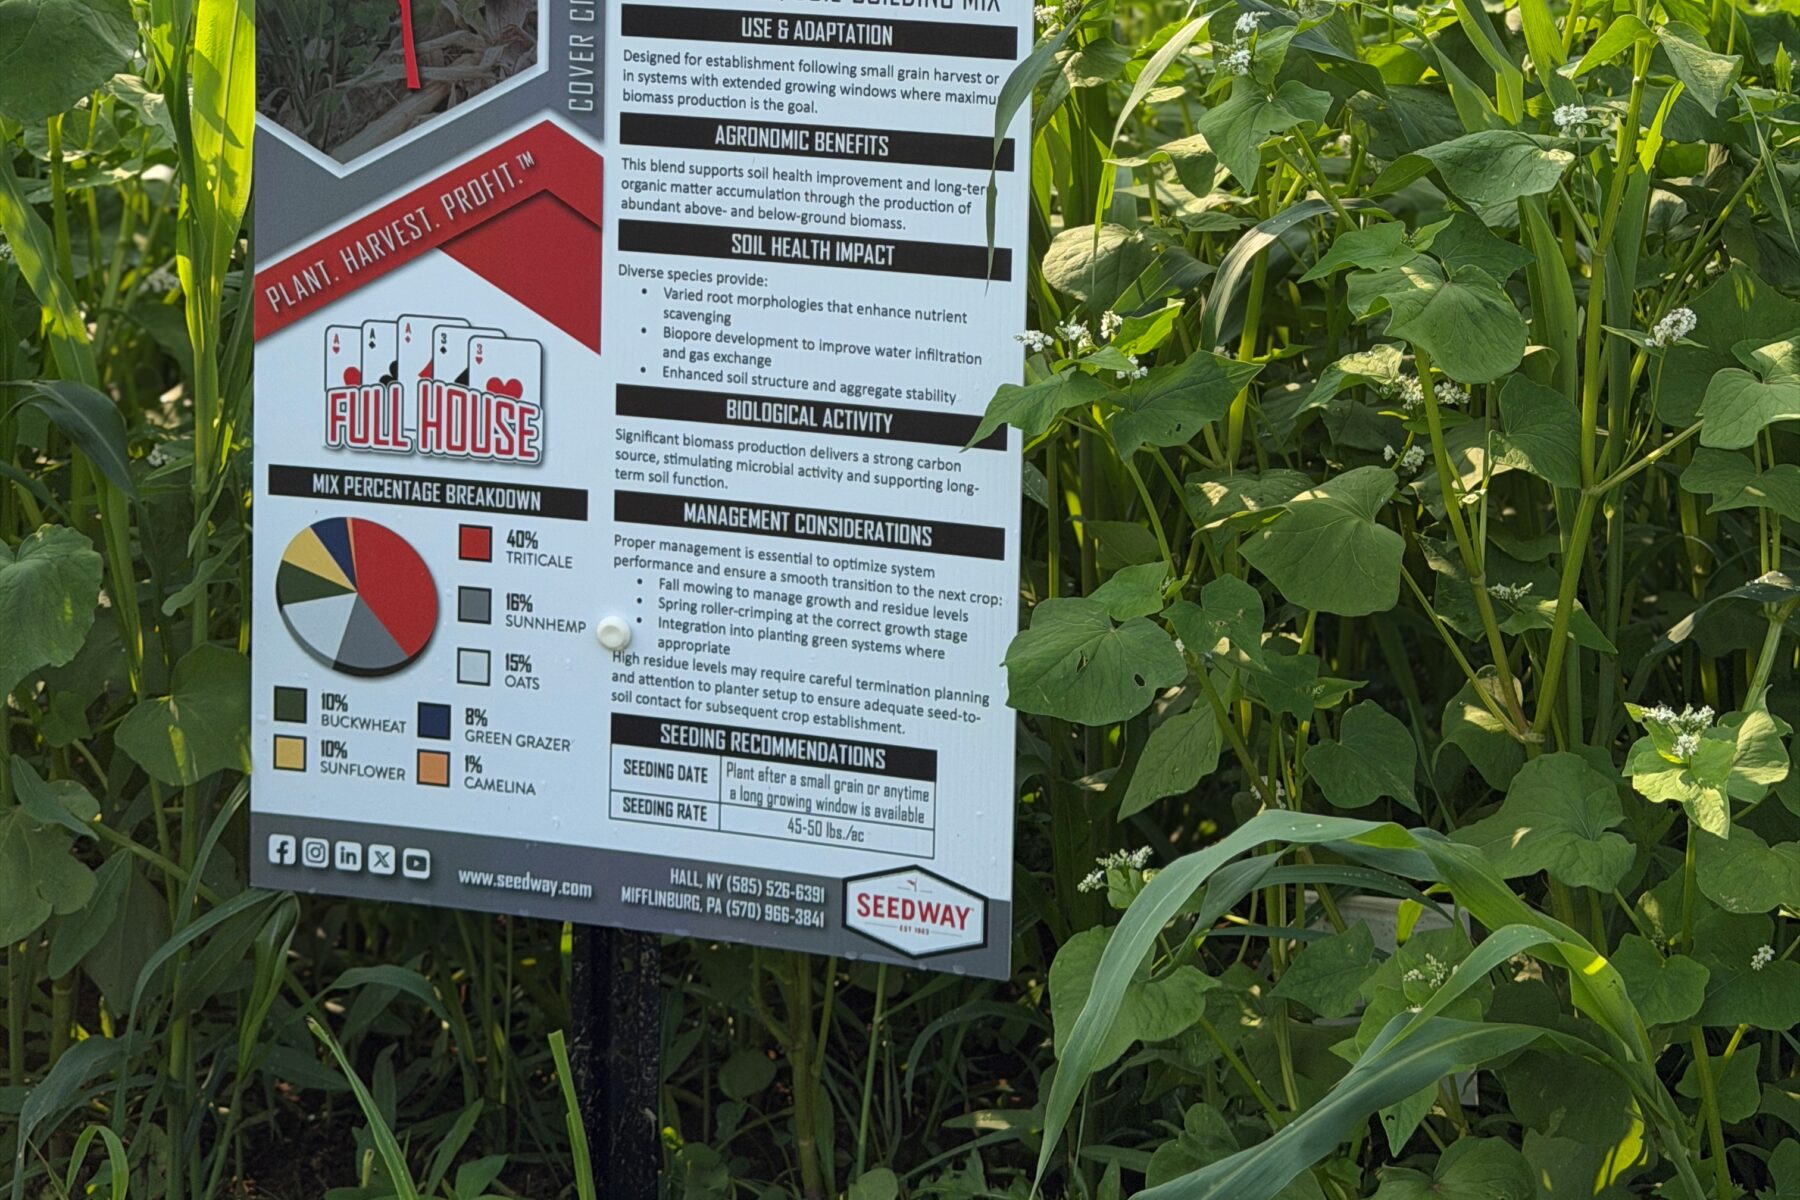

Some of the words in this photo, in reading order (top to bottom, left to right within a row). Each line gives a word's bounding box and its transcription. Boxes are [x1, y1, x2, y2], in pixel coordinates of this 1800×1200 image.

[741, 16, 772, 38] USE
[777, 18, 789, 39] &
[793, 19, 892, 45] ADAPTATION
[569, 35, 594, 112] COVER
[623, 49, 680, 66] Designed
[684, 52, 702, 66] for
[705, 55, 795, 72] establishment
[798, 59, 857, 78] following
[860, 64, 894, 77] small
[897, 66, 929, 82] grain
[934, 67, 982, 84] harvest
[985, 74, 1000, 85] or
[622, 88, 674, 104] biomass
[677, 93, 746, 108] production
[750, 96, 759, 110] is
[762, 97, 784, 111] the
[787, 100, 817, 115] goal.
[714, 124, 809, 150] AGRONOMIC
[814, 131, 888, 156] BENEFITS
[621, 157, 646, 171] This
[650, 158, 685, 174] blend
[688, 164, 744, 178] supports
[747, 166, 768, 179] soil
[772, 167, 812, 182] health
[816, 170, 902, 189] improvement
[906, 178, 930, 191] and
[934, 178, 987, 199] long-ter
[265, 259, 340, 313] PLANT.
[339, 206, 440, 274] HARVEST.
[440, 150, 536, 220] PROFIT.™
[731, 233, 766, 255] SOIL
[771, 236, 830, 260] HEALTH
[835, 241, 895, 265] IMPACT
[618, 263, 664, 279] Diverse
[667, 269, 713, 283] species
[716, 272, 768, 287] provide:
[663, 286, 703, 302] Varied
[706, 292, 733, 304] root
[736, 294, 823, 313] morphologies
[826, 299, 853, 314] that
[856, 302, 911, 319] enhance
[914, 308, 967, 324] nutrient
[329, 386, 409, 448] FULL
[420, 383, 536, 458] HOUSE
[726, 398, 818, 427] BIOLOGICAL
[822, 407, 893, 433] ACTIVITY
[615, 427, 679, 445] Significant
[682, 433, 734, 450] biomass
[737, 440, 806, 457] production
[809, 445, 858, 462] delivers
[862, 453, 869, 463] a
[873, 453, 913, 470] strong
[916, 456, 961, 472] carbon
[312, 473, 339, 494] MIX
[343, 475, 441, 502] PERCENTAGE
[445, 483, 541, 511] BREAKDOWN
[506, 528, 538, 549] 40%
[683, 502, 790, 531] MANAGEMENT
[794, 513, 932, 546] CONSIDERATIONS
[505, 550, 572, 569] TRITICALE
[614, 533, 656, 551] Proper
[659, 541, 741, 558] management
[744, 546, 754, 559] is
[757, 550, 813, 565] essential
[815, 554, 829, 567] to
[832, 557, 887, 573] optimize
[890, 564, 935, 578] system
[506, 592, 533, 613] 16%
[659, 577, 679, 591] Fall
[683, 582, 733, 599] mowing
[736, 585, 749, 598] to
[753, 589, 802, 606] manage
[805, 595, 851, 609] growth
[854, 599, 878, 612] and
[882, 602, 929, 618] residue
[932, 605, 968, 622] levels
[505, 613, 586, 633] SUNNHEMP
[505, 652, 532, 673] 15%
[504, 674, 540, 690] OATS
[321, 692, 348, 712] 10%
[611, 690, 632, 703] soil
[635, 694, 681, 708] contact
[684, 696, 702, 710] for
[705, 700, 778, 719] subsequent
[781, 710, 809, 725] crop
[812, 714, 905, 734] establishment.
[321, 713, 406, 733] BUCKWHEAT
[465, 707, 488, 727] 8%
[320, 739, 347, 759] 10%
[464, 728, 512, 746] GREEN
[515, 734, 571, 752] GRAZER
[660, 723, 726, 750] SEEDING
[730, 731, 885, 769] RECOMMENDATIONS
[320, 760, 406, 781] SUNFLOWER
[464, 754, 482, 774] 1%
[623, 758, 674, 780] SEEDING
[677, 764, 708, 784] DATE
[463, 775, 536, 796] CAMELINA
[726, 761, 754, 780] Plant
[757, 766, 787, 784] after
[789, 774, 796, 786] a
[800, 774, 830, 790] small
[833, 778, 863, 794] grain
[867, 783, 880, 795] or
[883, 785, 929, 802] anytime
[622, 798, 673, 818] SEEDING
[676, 803, 707, 822] RATE
[729, 789, 736, 800] a
[740, 786, 763, 806] long
[767, 791, 812, 813] growing
[816, 796, 857, 815] window
[862, 802, 871, 817] is
[875, 806, 925, 824] available
[787, 818, 822, 837] 45-50
[825, 822, 864, 842] lbs./ac
[458, 869, 592, 897] www.seedway.com
[670, 867, 703, 888] HALL,
[706, 872, 723, 889] NY
[726, 874, 762, 896] (585)
[765, 879, 824, 903] 526-6391
[621, 885, 702, 912] MIFFLINBURG,
[706, 896, 722, 914] PA
[725, 898, 761, 920] (570)
[764, 903, 824, 927] 966-3841
